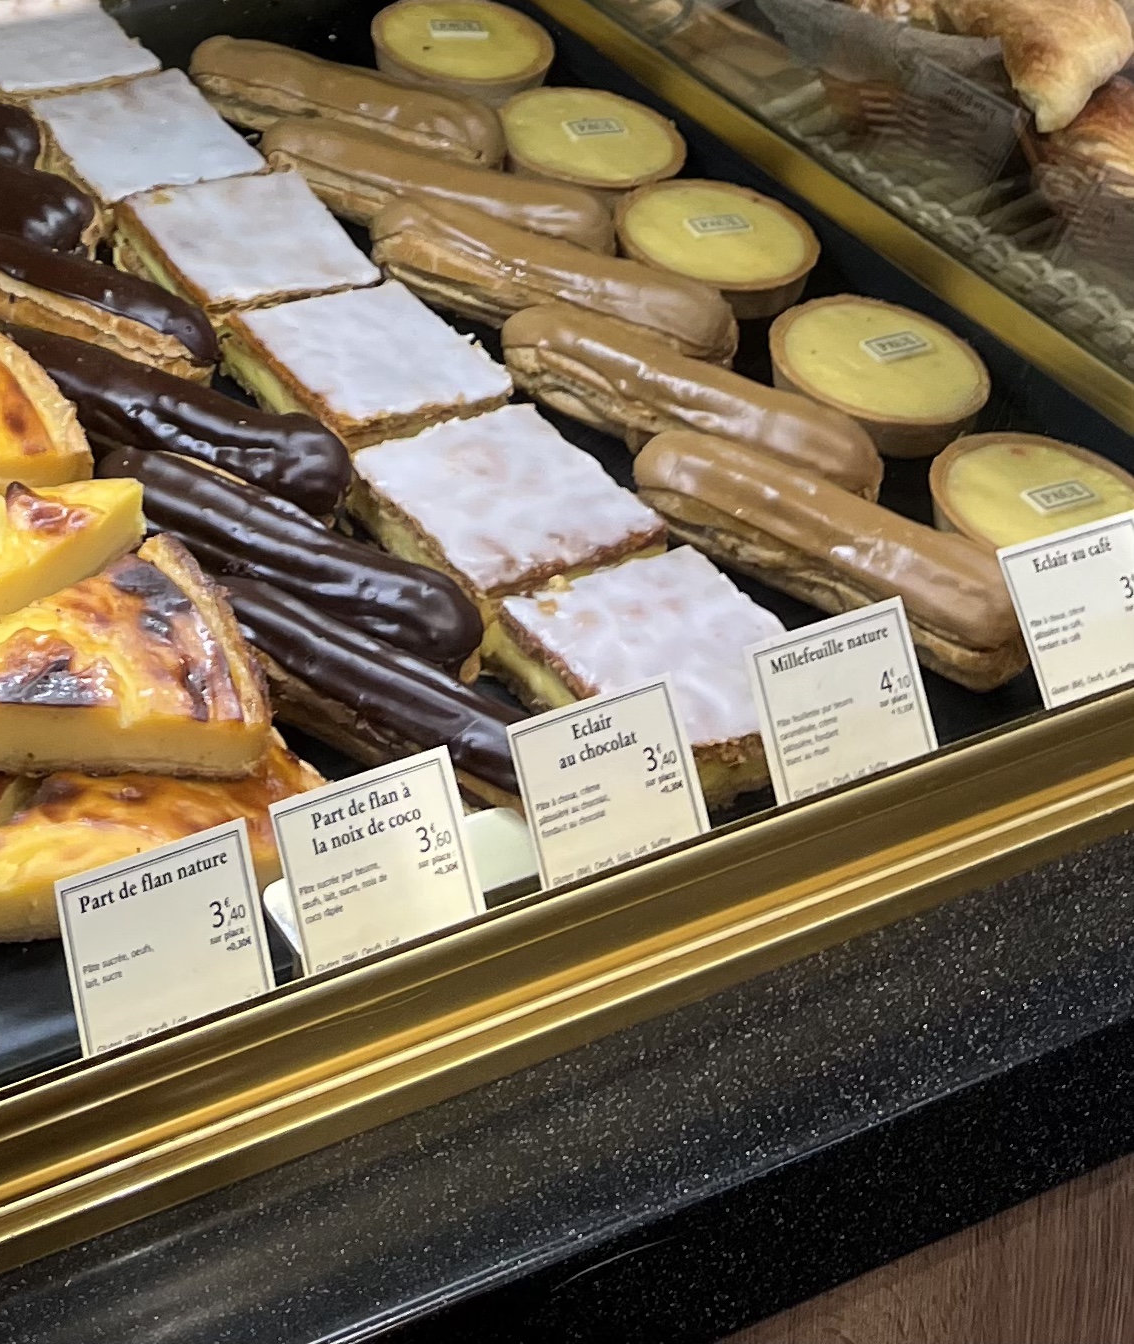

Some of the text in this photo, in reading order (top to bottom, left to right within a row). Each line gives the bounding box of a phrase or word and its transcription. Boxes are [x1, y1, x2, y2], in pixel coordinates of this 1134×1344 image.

[1032, 536, 1112, 574] Eclair au café
[770, 626, 889, 675] Millefeuille nature
[559, 731, 638, 770] au chocolat
[571, 713, 613, 740] Eclair
[311, 781, 412, 830] Part de flan à
[312, 808, 422, 856] la noix de coco
[78, 851, 229, 914] Part de flan nature
